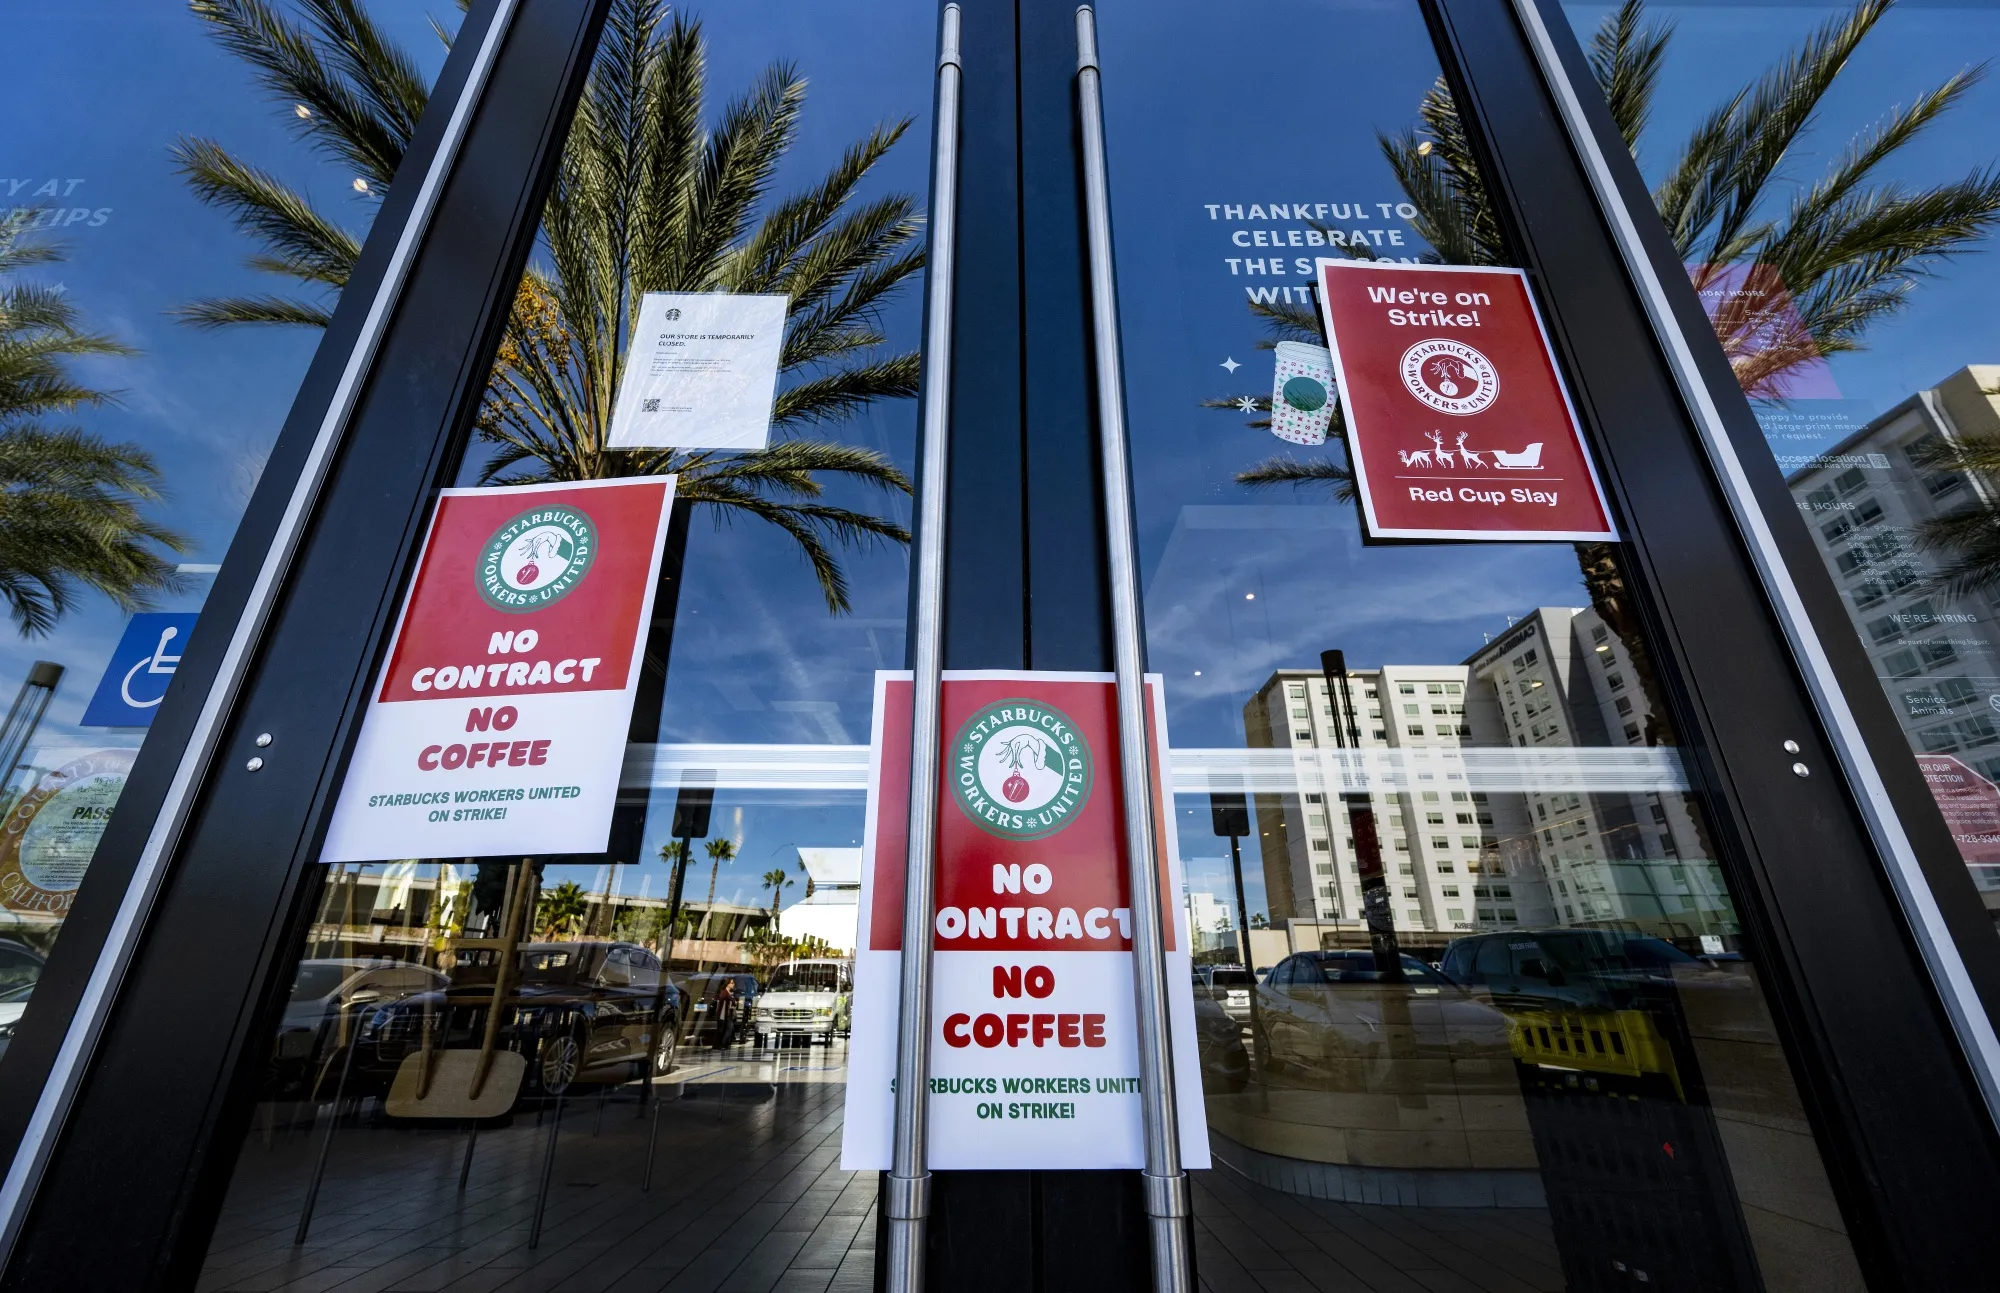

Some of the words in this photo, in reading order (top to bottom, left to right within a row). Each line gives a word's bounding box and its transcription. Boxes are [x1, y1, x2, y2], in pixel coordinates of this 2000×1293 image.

[32, 179, 85, 196] AT
[1204, 203, 1370, 220] THANKFUL
[1376, 203, 1418, 219] TO
[1232, 229, 1405, 247] CELEBRATE
[1225, 258, 1286, 275] THE
[1367, 286, 1448, 305] We're
[1455, 292, 1491, 306] on
[1388, 308, 1481, 327] Strike!
[1409, 343, 1481, 364] STARBUCKS
[1407, 369, 1459, 410] WORKERS
[1468, 372, 1493, 409] UNITED
[1756, 413, 1789, 422] happy
[1793, 413, 1805, 421] to
[1809, 413, 1849, 421] provide
[1774, 423, 1831, 431] large-print
[1774, 454, 1816, 463] Access
[1816, 454, 1866, 463] location
[1408, 487, 1454, 502] Red
[1458, 487, 1506, 506] Cup
[1510, 488, 1558, 507] Slay
[501, 511, 588, 543] STARBUCKS
[484, 551, 528, 605] WORKERS
[540, 546, 588, 600] UNITED
[1889, 614, 1930, 623] WE'RE
[1932, 614, 1977, 623] HIRING
[487, 629, 539, 655] NO
[411, 657, 601, 692] CONTRACT
[1905, 695, 1946, 704] Service
[465, 705, 518, 733] NO
[1911, 706, 1954, 715] Animals
[969, 707, 1075, 745] STARBUCKS
[417, 739, 552, 772] COFFEE
[1933, 763, 1952, 771] OUR
[368, 791, 450, 807] STARBUCKS
[454, 788, 525, 803] WORKERS
[528, 786, 581, 800] UNITED
[960, 755, 1023, 829] WORKERS
[1038, 758, 1083, 826] UNITED
[72, 807, 115, 820] PASS
[428, 810, 450, 822] ON
[452, 807, 508, 822] STRIKE!
[992, 863, 1053, 895] NO
[935, 906, 1132, 939] ONTRACT
[992, 965, 1055, 999] NO
[943, 1012, 1106, 1048] COFFEE
[1002, 1077, 1091, 1094] WORKERS
[1096, 1077, 1141, 1094] UNIT
[976, 1102, 1002, 1119] ON
[1008, 1102, 1075, 1119] STRIKE!
